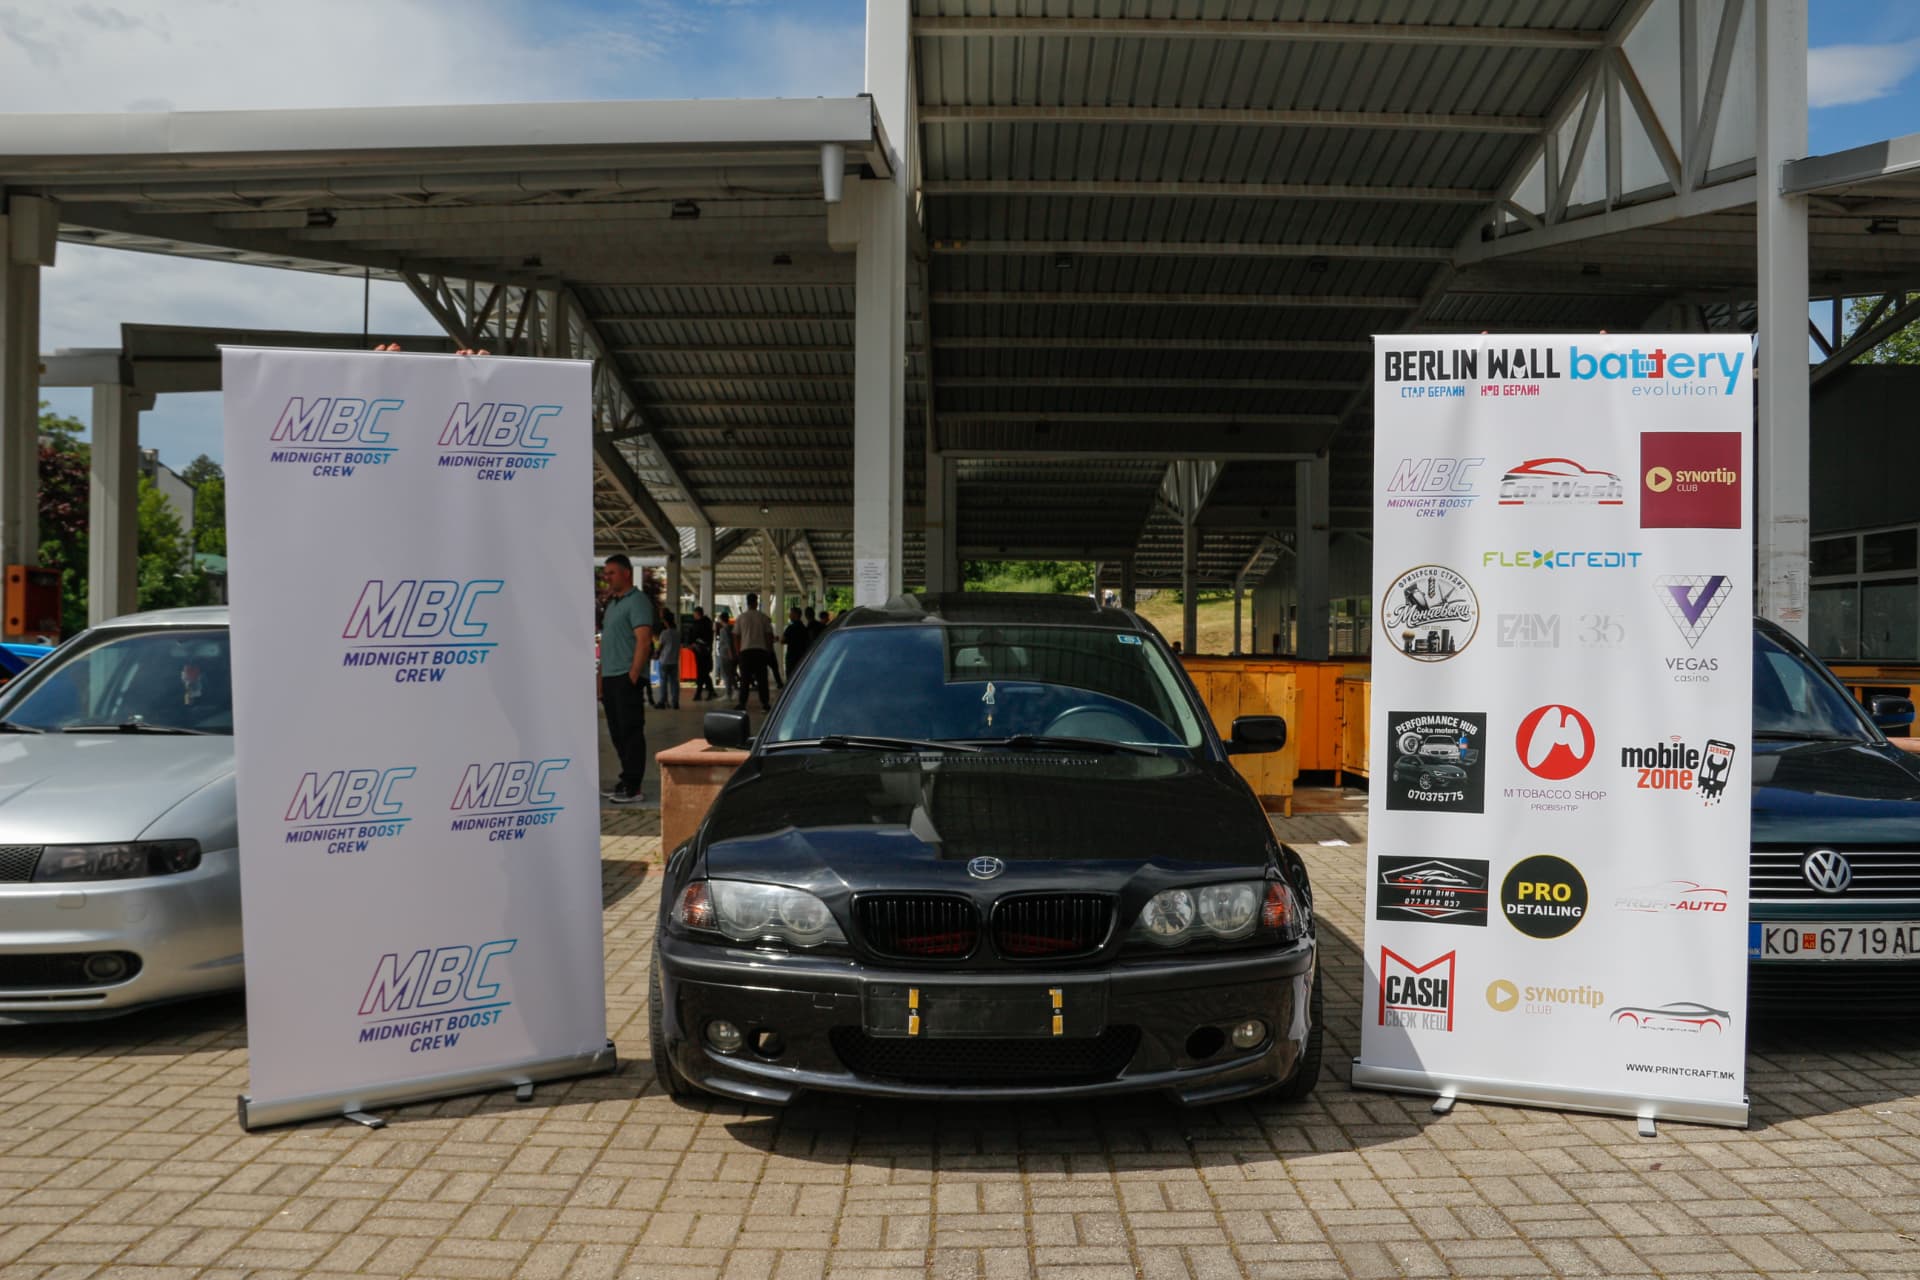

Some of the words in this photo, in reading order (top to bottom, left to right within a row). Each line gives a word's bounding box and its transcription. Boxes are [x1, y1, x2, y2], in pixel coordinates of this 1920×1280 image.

[1384, 349, 1478, 381] BERLIN
[1488, 347, 1561, 379] WALL
[1570, 346, 1744, 395] battery
[1428, 385, 1465, 397] БЕРЛИН
[1503, 384, 1540, 396] БЕРЛИН
[1631, 381, 1718, 396] evolution
[270, 396, 404, 443] MBC
[437, 402, 563, 448] MBC
[270, 452, 342, 463] MIDNIGHT
[343, 452, 391, 464] BOOST
[438, 456, 504, 467] MIDNIGHT
[505, 457, 549, 469] BOOST
[312, 465, 355, 477] CREW
[477, 469, 516, 480] CREW
[1386, 457, 1486, 492] MBC
[1499, 481, 1544, 498] Car
[1551, 481, 1623, 498] Wash
[1676, 484, 1698, 492] CLUB
[1386, 499, 1437, 508] MIDNIGHT
[1438, 499, 1473, 508] BOOST
[1416, 509, 1447, 518] CREW
[342, 580, 504, 639] MBC
[343, 651, 430, 667] MIDNIGHT
[432, 650, 489, 664] BOOST
[1665, 657, 1719, 671] VEGAS
[395, 668, 446, 682] CREW
[1674, 672, 1710, 682] casino
[1395, 715, 1459, 735] PERFORMANCE
[1459, 720, 1478, 736] HUB
[1621, 742, 1699, 769] mobile
[450, 758, 571, 810] MBC
[1637, 768, 1693, 790] zone
[284, 766, 416, 821] MBC
[1407, 789, 1464, 802] 070375775
[1503, 788, 1513, 798] M
[1516, 789, 1571, 800] TOBACCO
[1574, 790, 1607, 800] SHOP
[451, 816, 514, 831] MIDNIGHT
[516, 812, 557, 826] BOOST
[285, 827, 357, 843] MIDNIGHT
[358, 824, 405, 838] BOOST
[489, 828, 526, 842] CREW
[327, 841, 369, 854] CREW
[1518, 881, 1571, 902] PRO
[1506, 904, 1582, 917] DETAILING
[1765, 928, 1799, 954] KO
[1820, 928, 1888, 954] 6719
[357, 939, 518, 1015] MBC
[1386, 975, 1448, 1009] CASH
[1525, 1005, 1552, 1015] CLUB
[358, 1018, 445, 1043] MIDNIGHT
[446, 1010, 503, 1031] BOOST
[1385, 1010, 1416, 1029] СВЕЖ
[410, 1033, 460, 1053] CREW
[1626, 1063, 1736, 1080] WWW.PRINTCRAFT.MK
